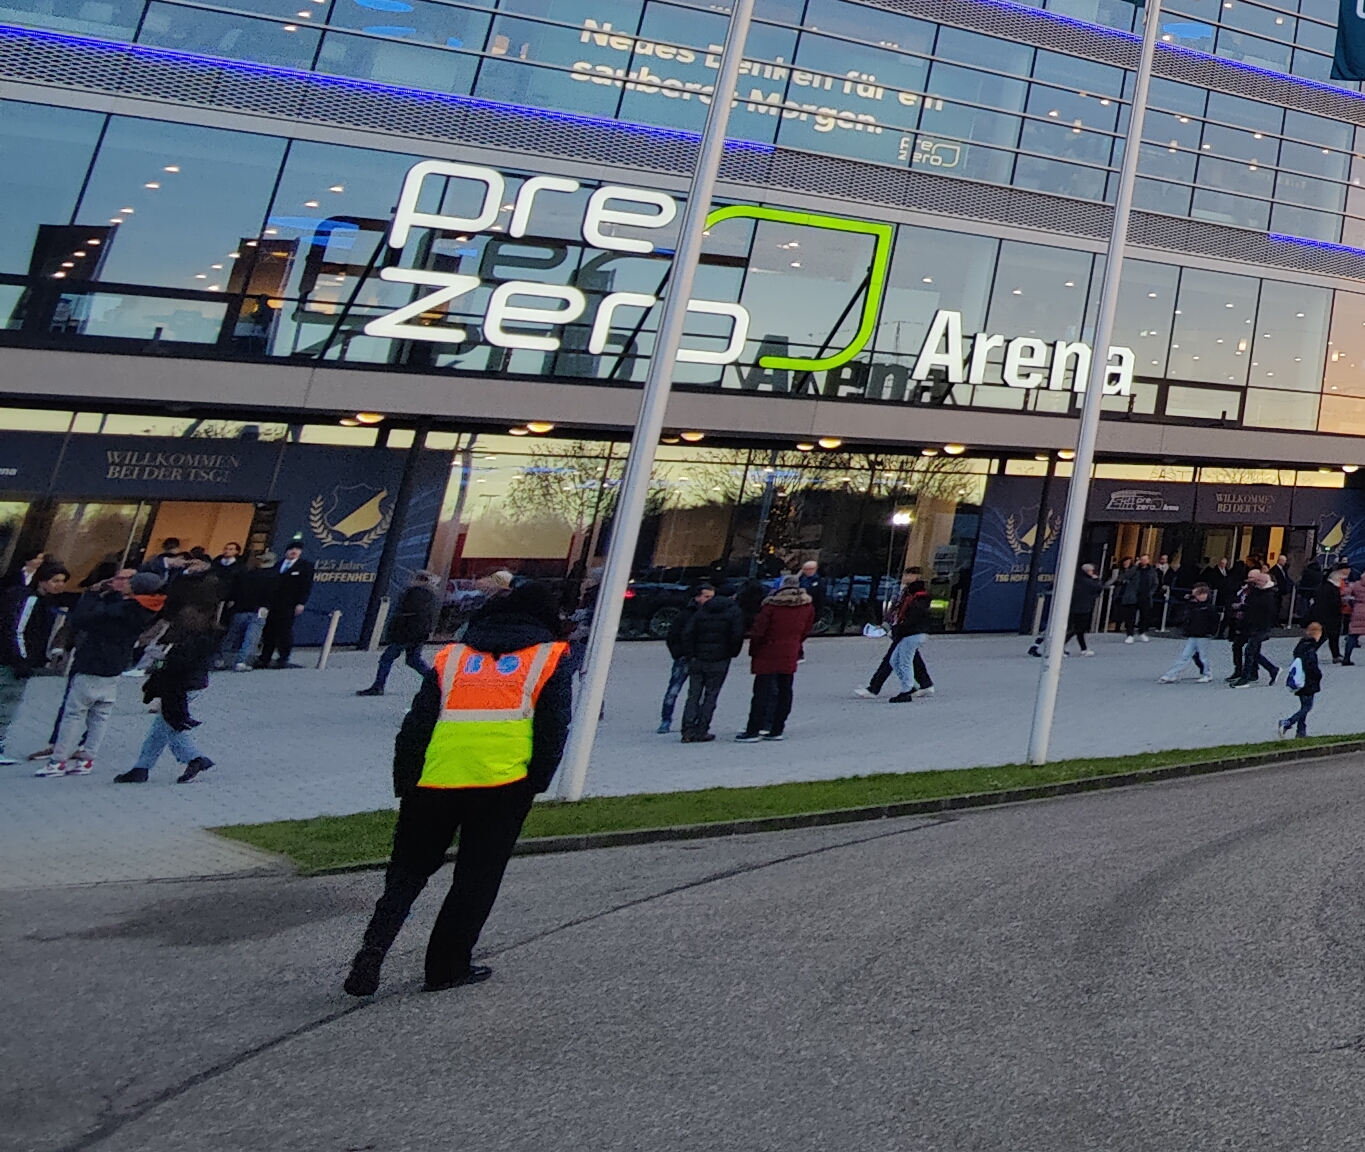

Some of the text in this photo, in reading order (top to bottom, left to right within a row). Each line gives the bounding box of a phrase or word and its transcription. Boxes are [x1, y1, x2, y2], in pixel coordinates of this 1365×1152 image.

[580, 19, 695, 63] Neues
[842, 70, 884, 100] für
[897, 91, 944, 111] en
[747, 88, 882, 134] Morgen.
[388, 160, 678, 253] pre
[364, 266, 750, 365] zero
[911, 309, 1136, 396] Arena
[106, 450, 239, 468] WILLKOMMEN
[107, 466, 140, 479] BEI
[142, 467, 183, 481] DER
[1216, 493, 1275, 503] WILLKOMMEN
